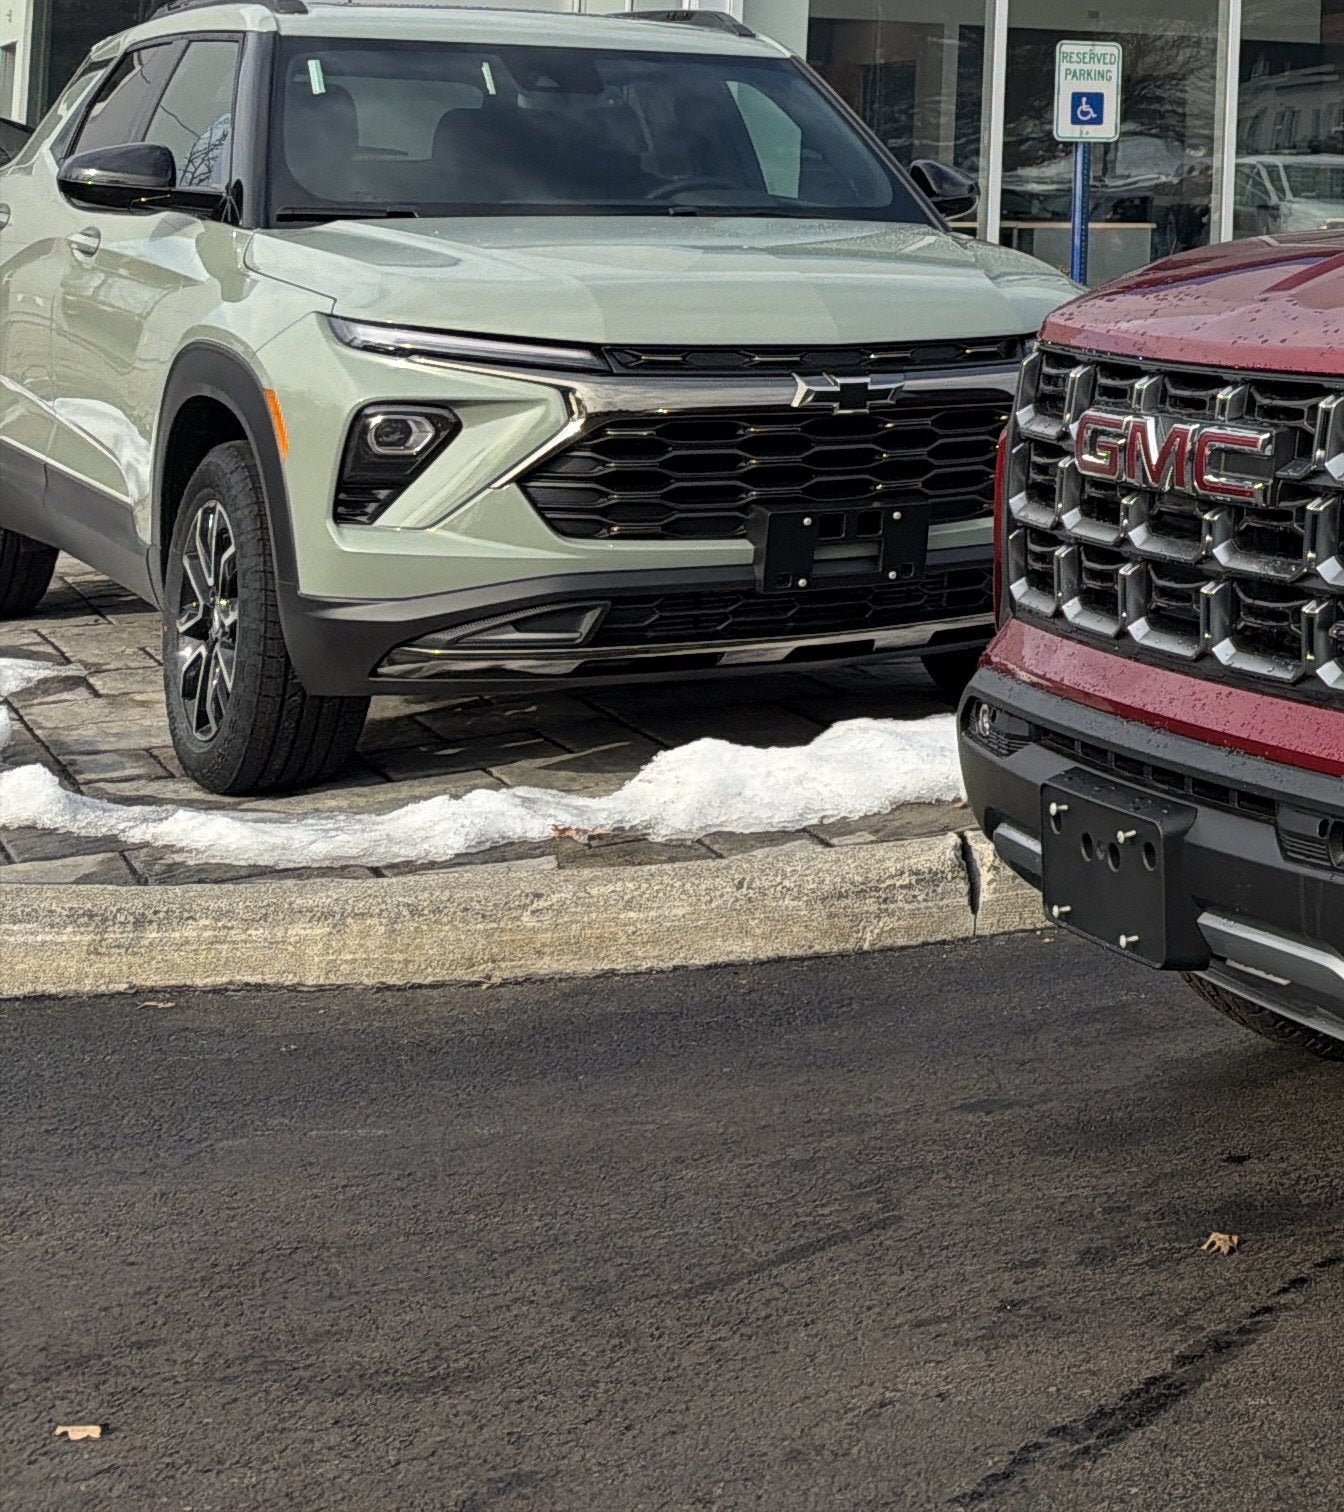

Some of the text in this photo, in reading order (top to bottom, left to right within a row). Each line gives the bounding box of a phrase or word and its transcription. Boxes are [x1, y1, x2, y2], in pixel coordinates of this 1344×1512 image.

[1061, 51, 1117, 65] RESERVED
[1064, 68, 1113, 81] PARKING
[1075, 410, 1276, 508] GMC
